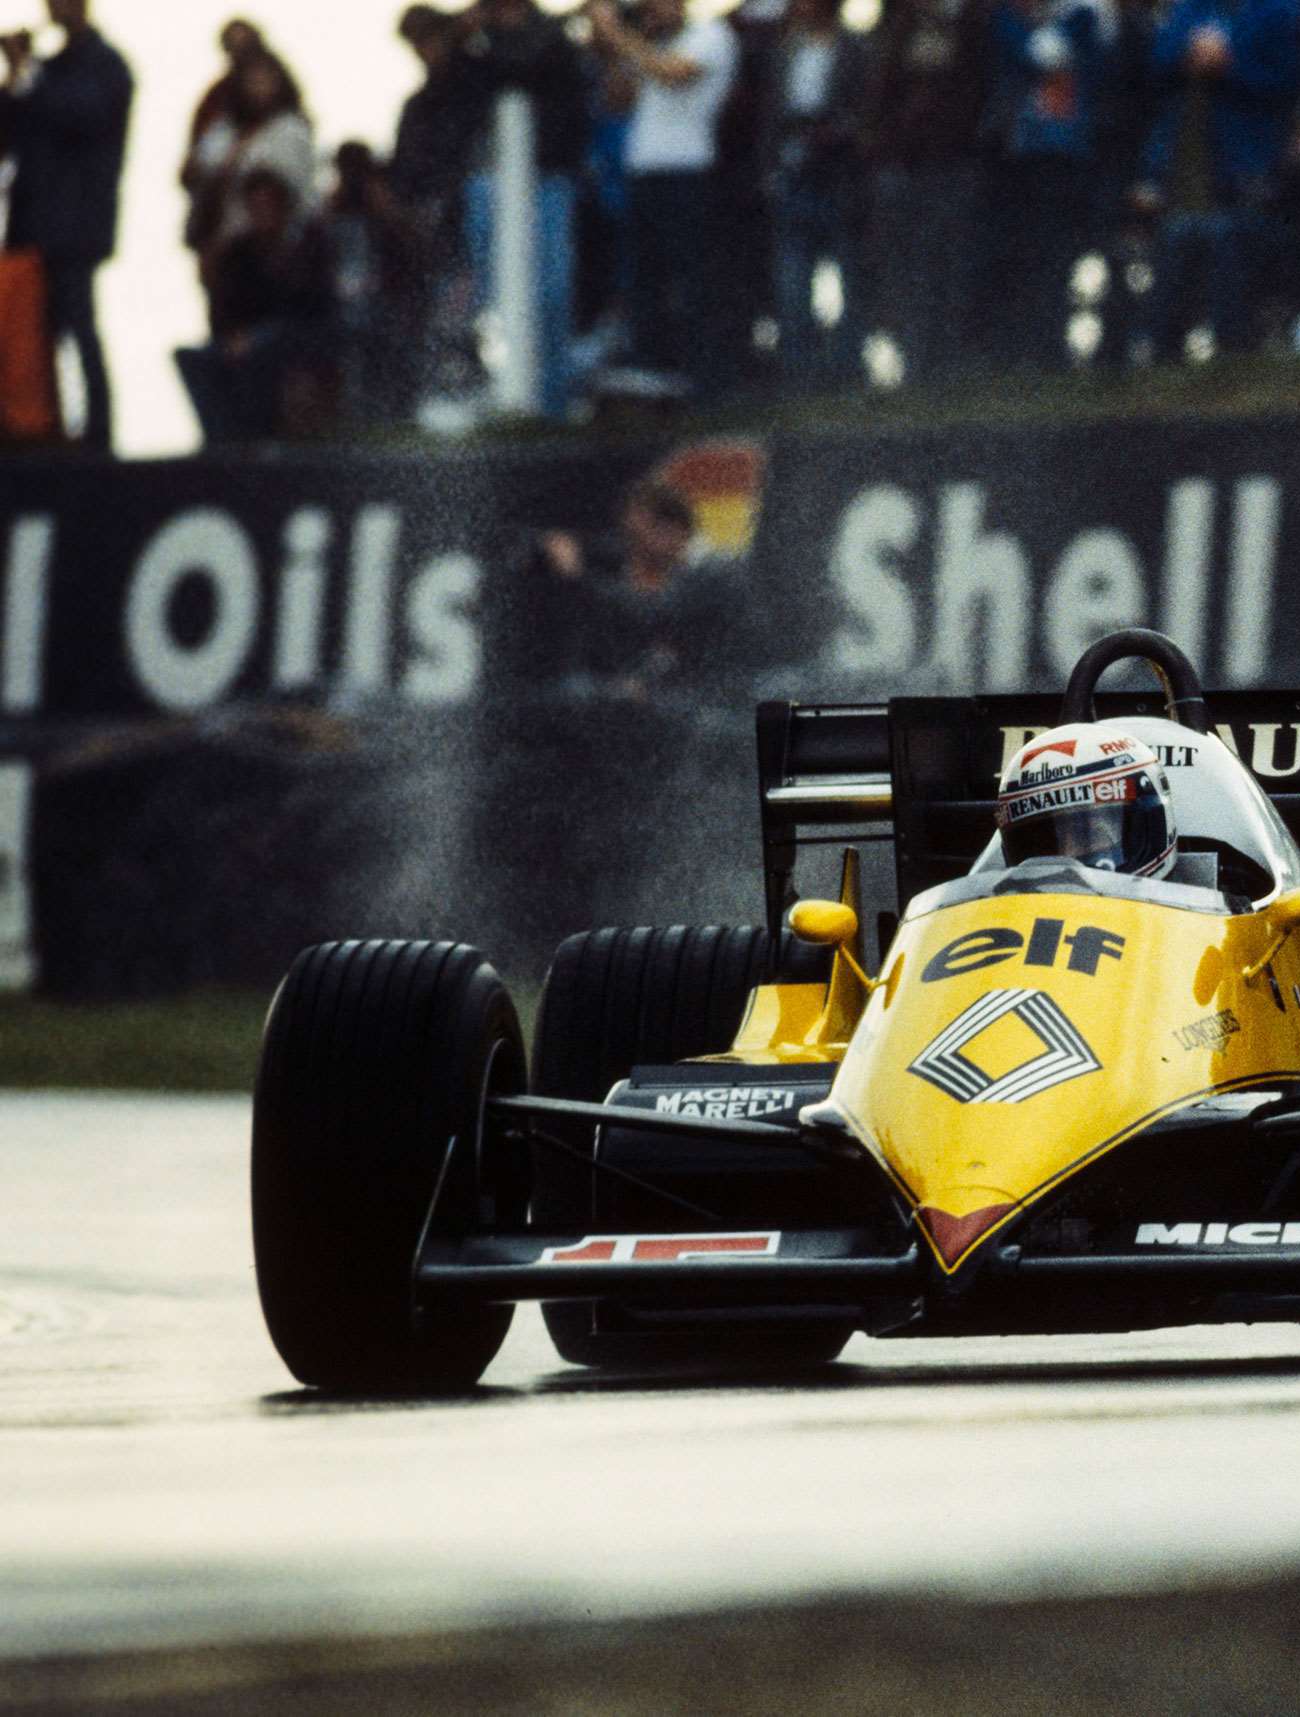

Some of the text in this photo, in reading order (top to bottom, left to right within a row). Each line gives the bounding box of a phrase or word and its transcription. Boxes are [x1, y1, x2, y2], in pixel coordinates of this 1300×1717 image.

[830, 474, 1282, 694] Shell
[125, 505, 482, 712] Oils
[1020, 762, 1074, 785] Marlboro
[1009, 778, 1127, 819] RENAULT elf
[921, 917, 1126, 983] elf
[656, 1086, 795, 1111] MAGNETI
[656, 1096, 795, 1120] MARELLI
